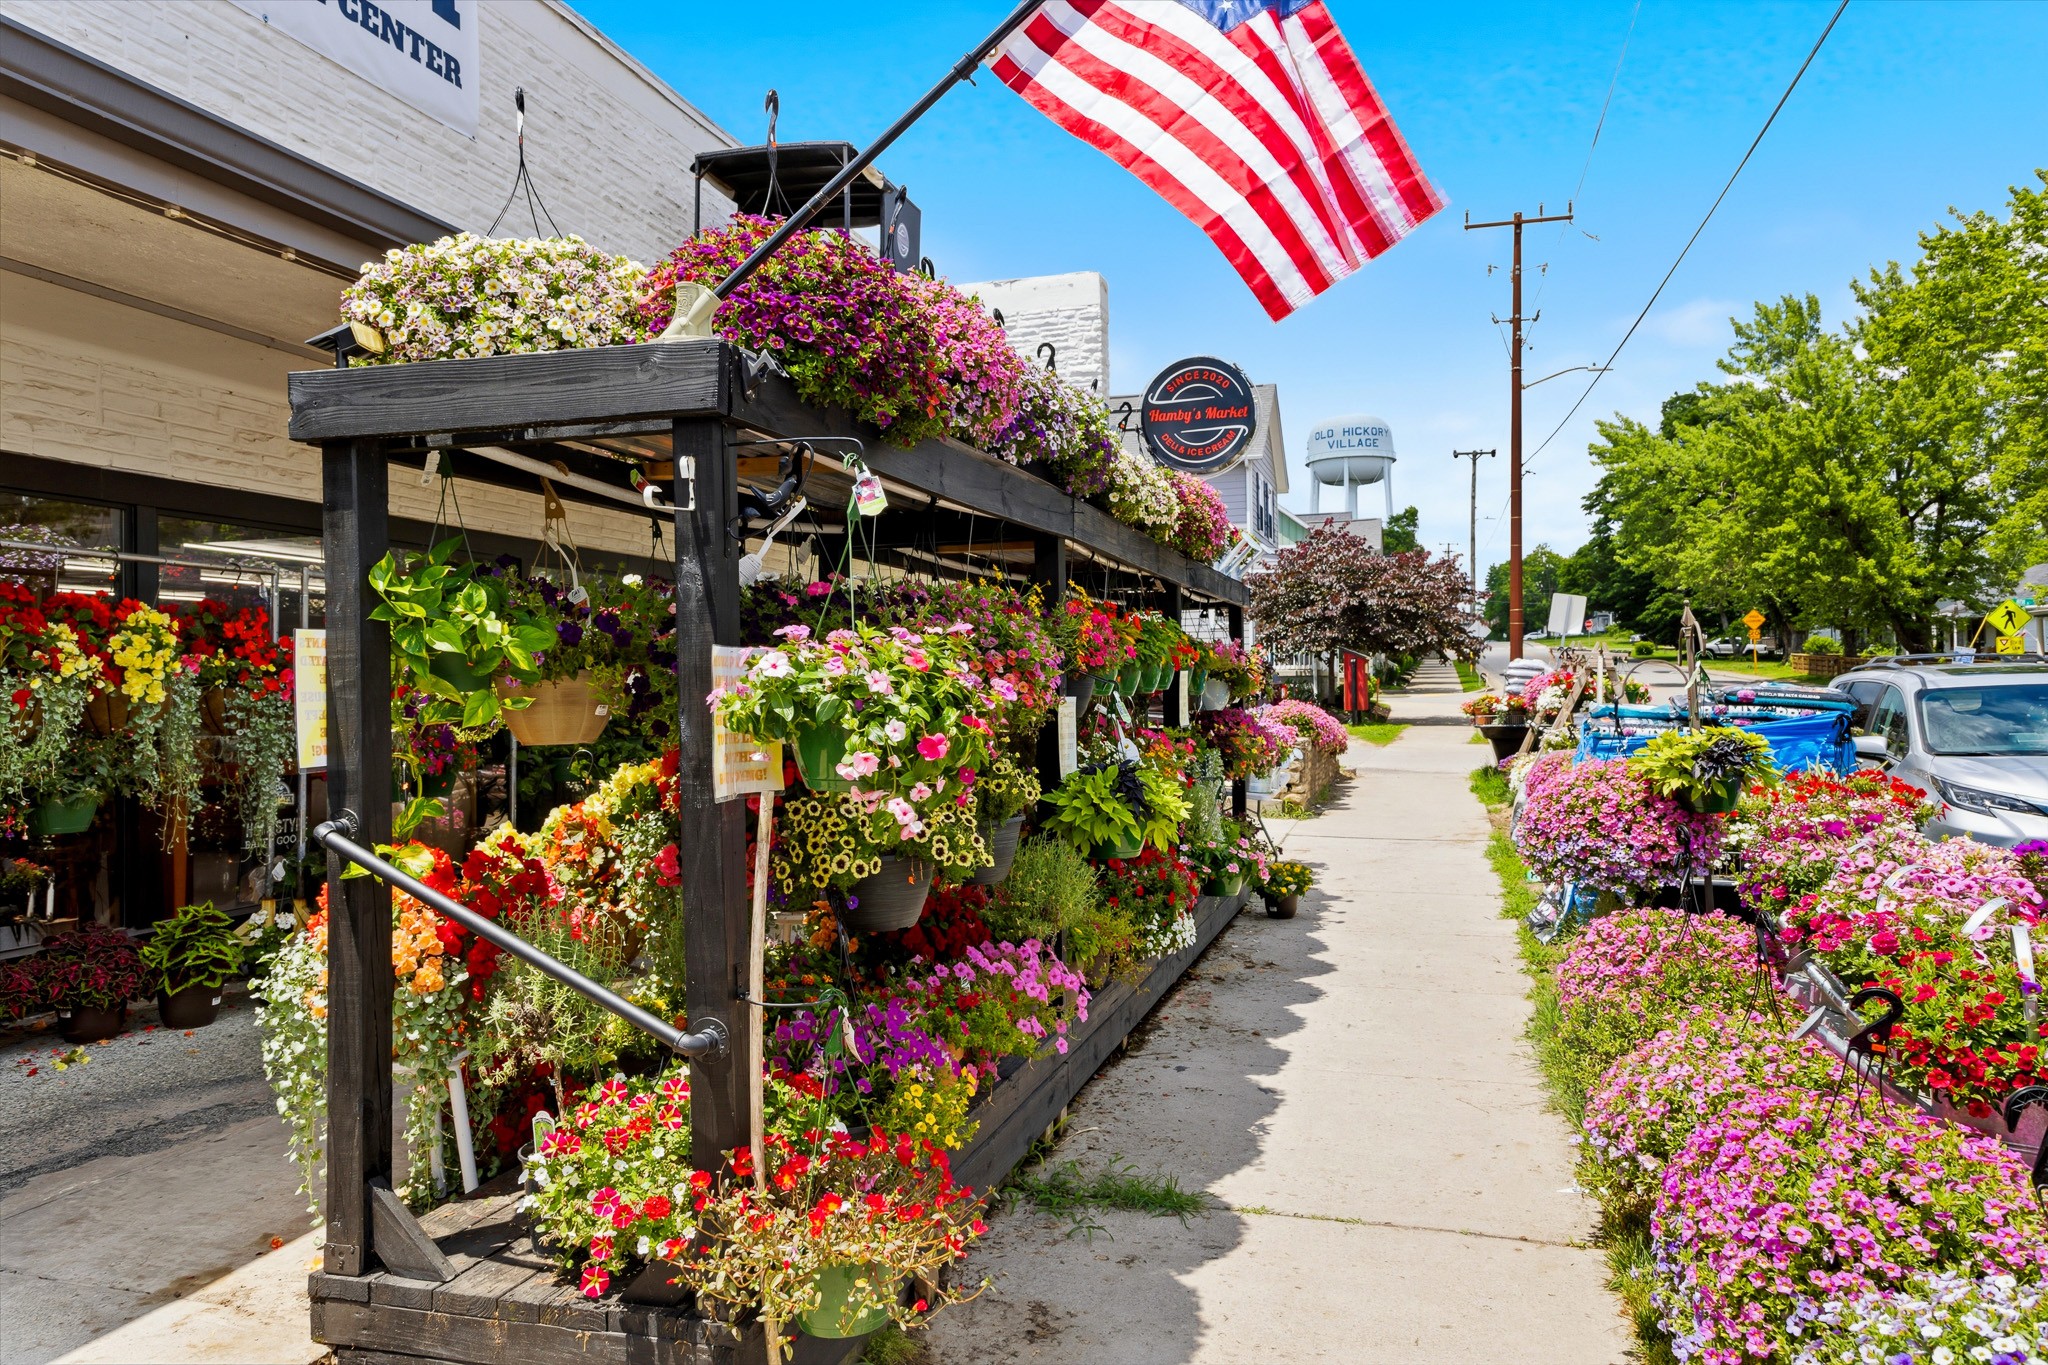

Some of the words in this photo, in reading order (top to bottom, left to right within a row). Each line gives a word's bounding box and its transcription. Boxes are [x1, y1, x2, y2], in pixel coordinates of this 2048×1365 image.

[338, 0, 462, 90] CENTER
[1166, 370, 1200, 393] SINCE
[1203, 370, 1230, 389] 2020
[1149, 407, 1202, 424] Hamby's
[1205, 405, 1249, 420] Market
[1161, 432, 1178, 451] DELI
[1178, 446, 1186, 455] &
[1314, 428, 1334, 441] OLD
[1342, 426, 1389, 437] HICKORY
[1327, 438, 1379, 449] VILLAGE
